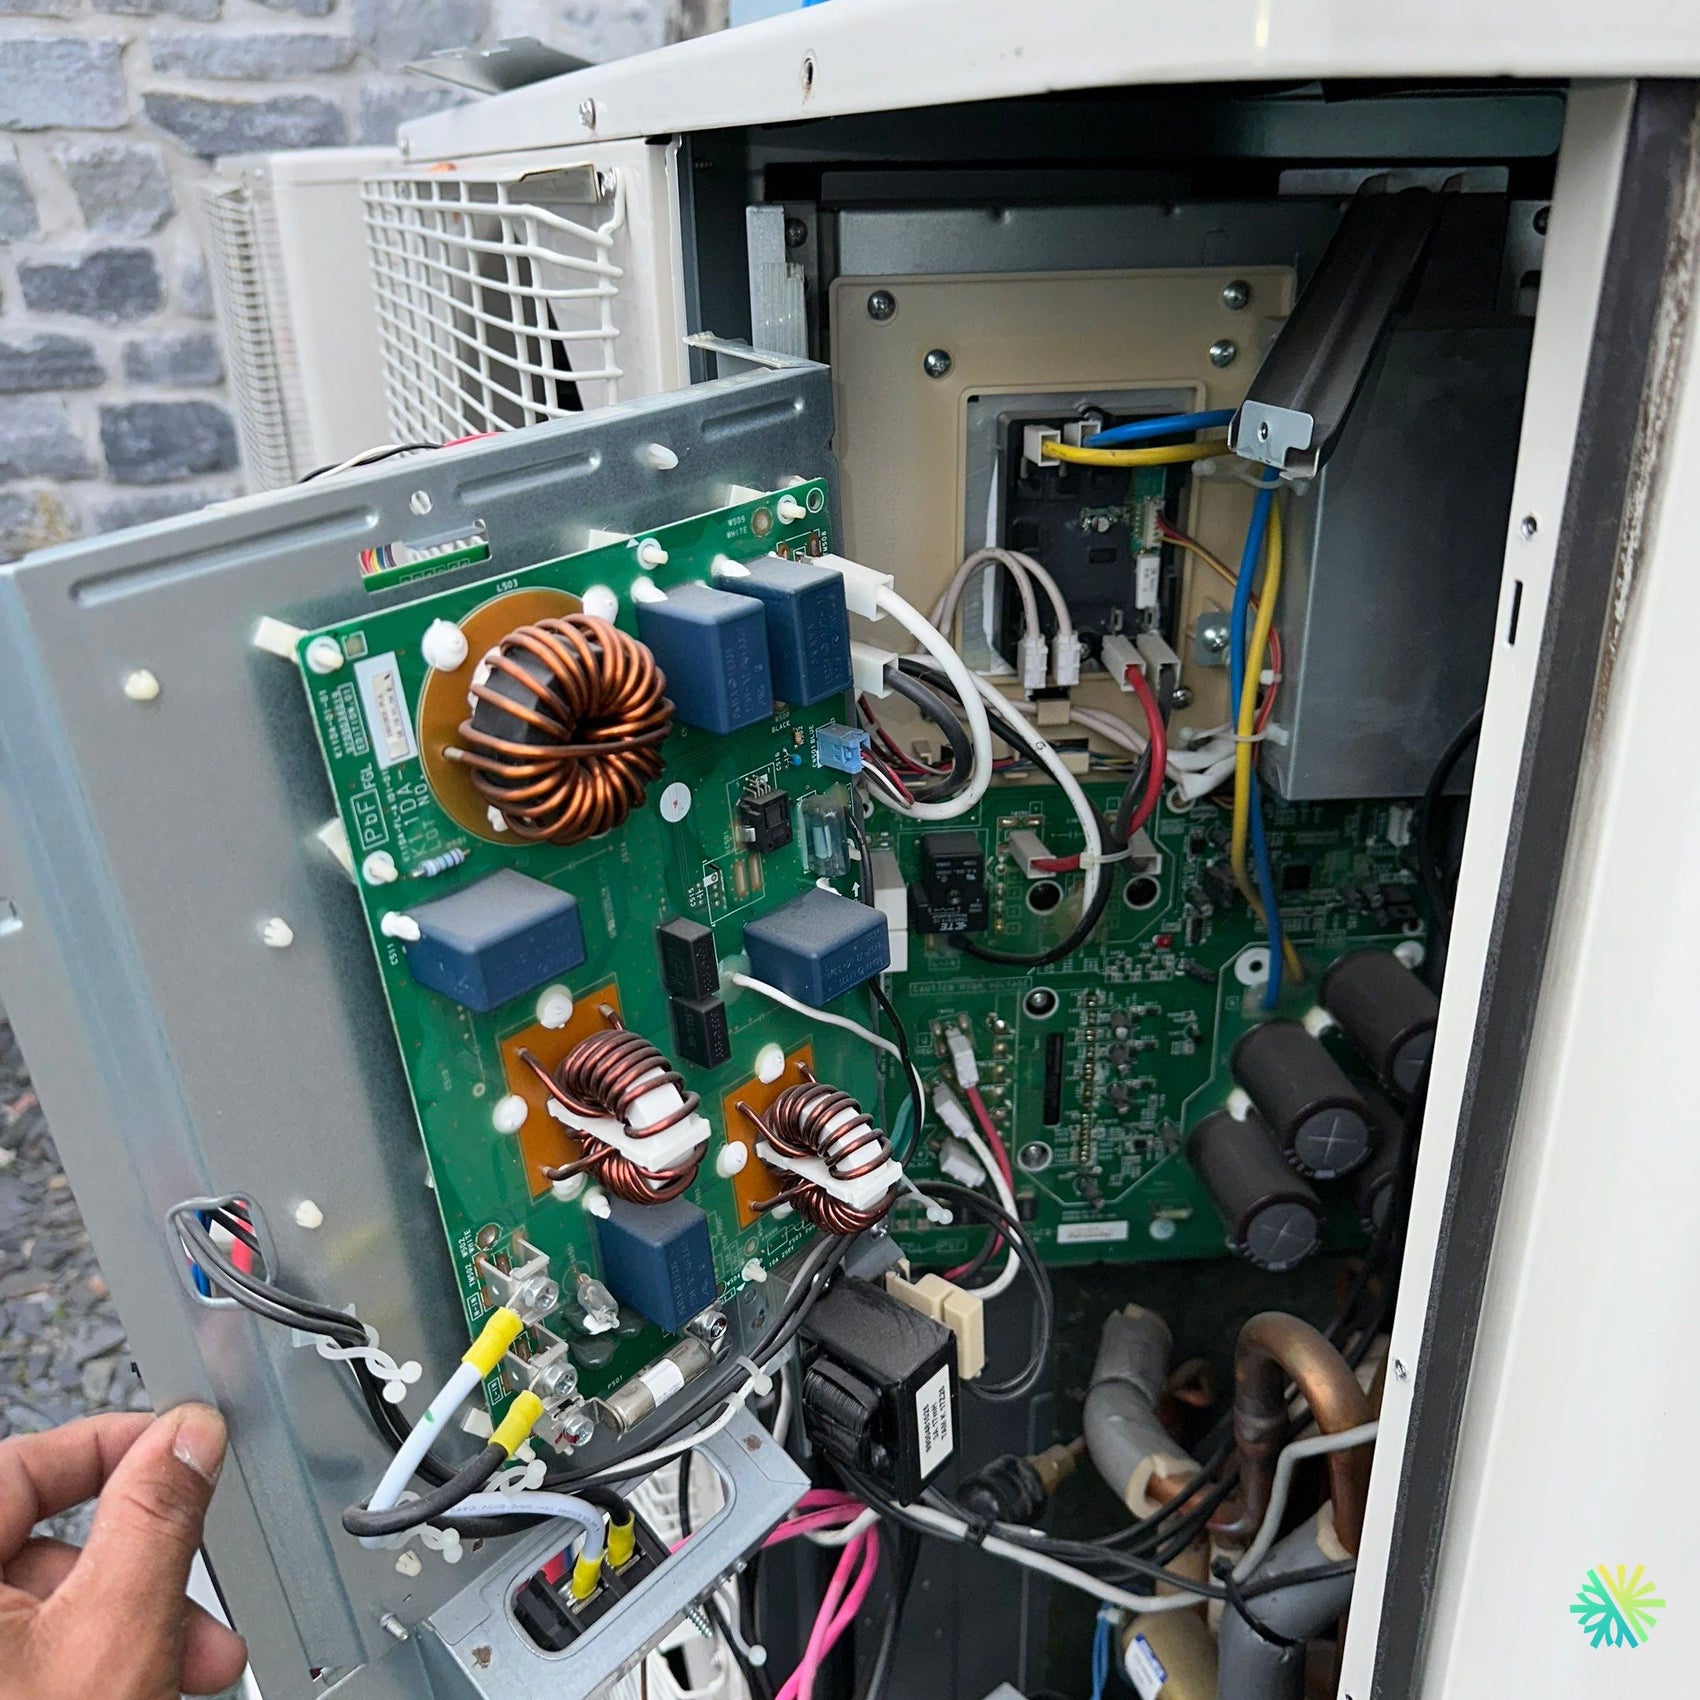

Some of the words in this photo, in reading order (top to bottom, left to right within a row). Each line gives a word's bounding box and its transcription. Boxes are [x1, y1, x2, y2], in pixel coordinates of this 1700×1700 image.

[726, 526, 748, 539] WHITE
[496, 578, 518, 592] L503
[771, 720, 791, 734] BLACK
[808, 724, 816, 744] BLUE
[360, 762, 376, 790] FGL
[414, 774, 430, 807] NO.
[356, 801, 384, 844] PbF
[422, 819, 443, 852] LOT
[688, 887, 697, 908] C515
[387, 943, 399, 966] C511
[463, 1228, 475, 1254] WHITE
